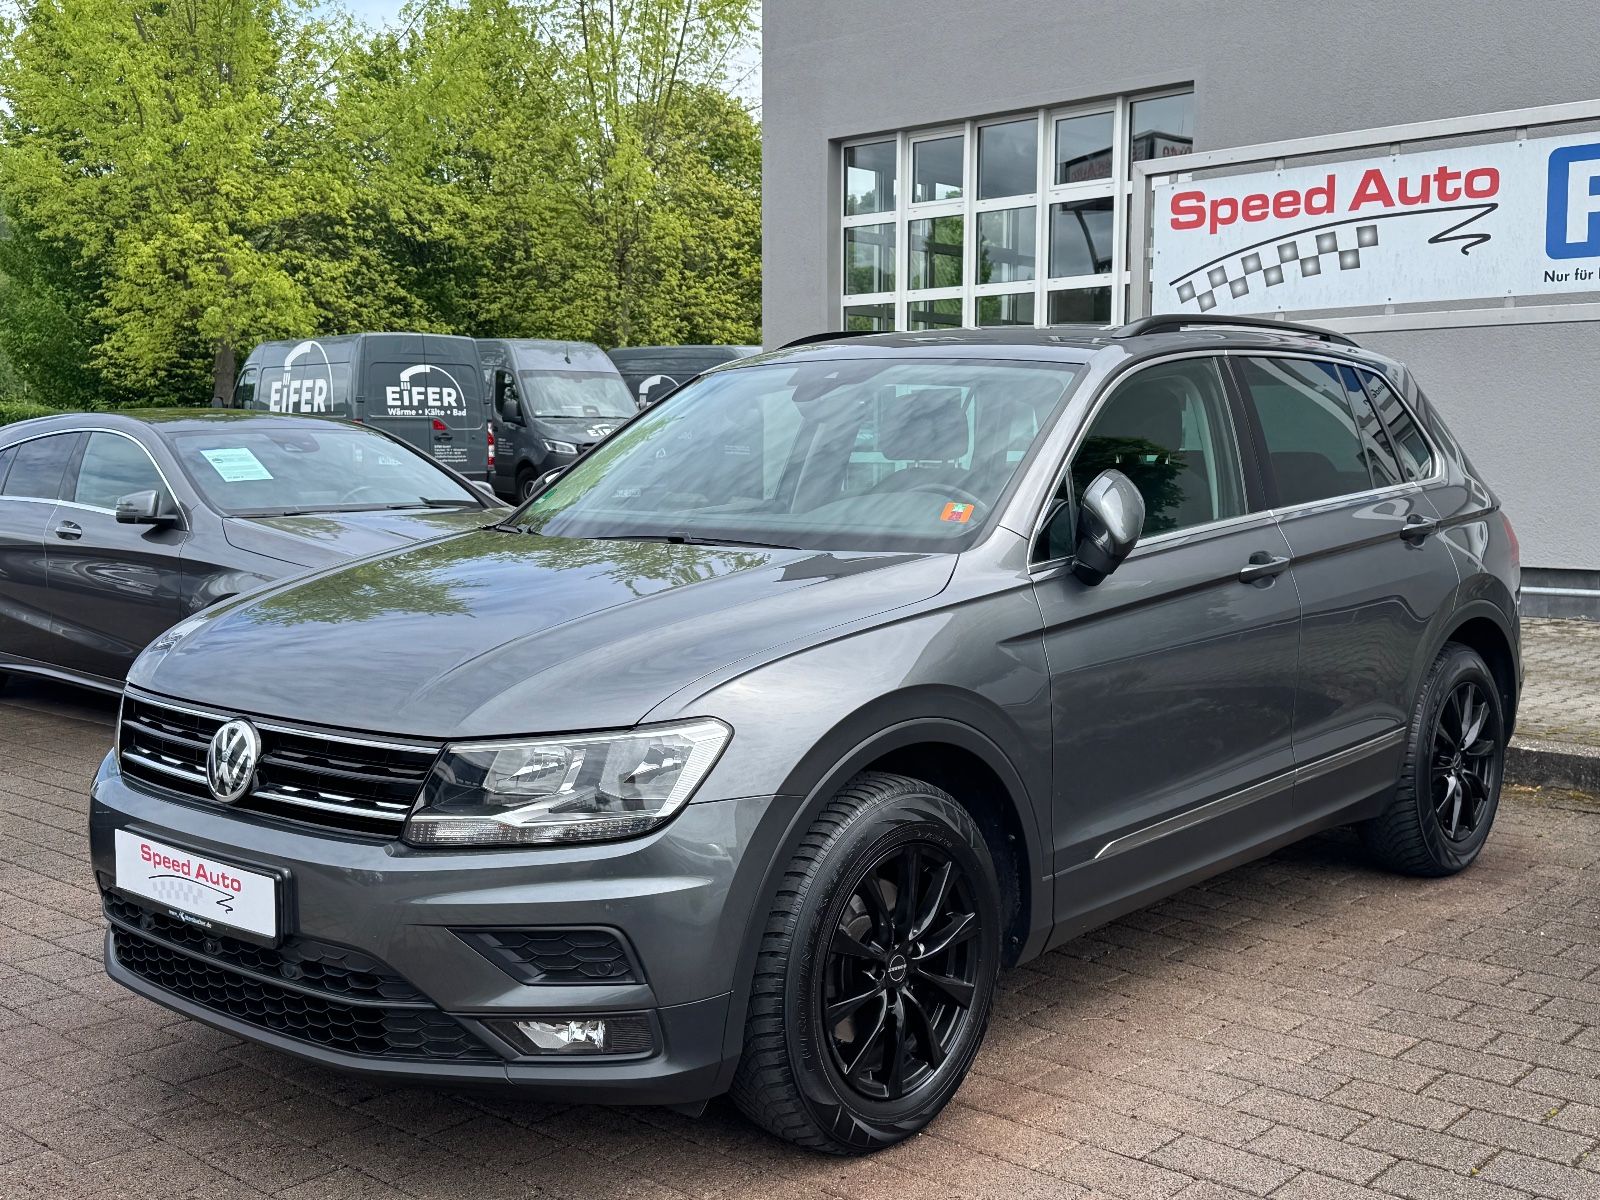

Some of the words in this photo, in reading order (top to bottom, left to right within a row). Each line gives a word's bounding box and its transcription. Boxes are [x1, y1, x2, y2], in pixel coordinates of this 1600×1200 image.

[1170, 174, 1336, 234] Speed
[1348, 166, 1500, 211] Auto
[1544, 270, 1570, 282] Nur
[1575, 267, 1593, 280] für
[387, 407, 416, 416] Wärme
[425, 408, 445, 416] Kälte
[452, 408, 467, 416] Bad
[140, 843, 191, 876] Speed
[195, 863, 242, 892] Auto
